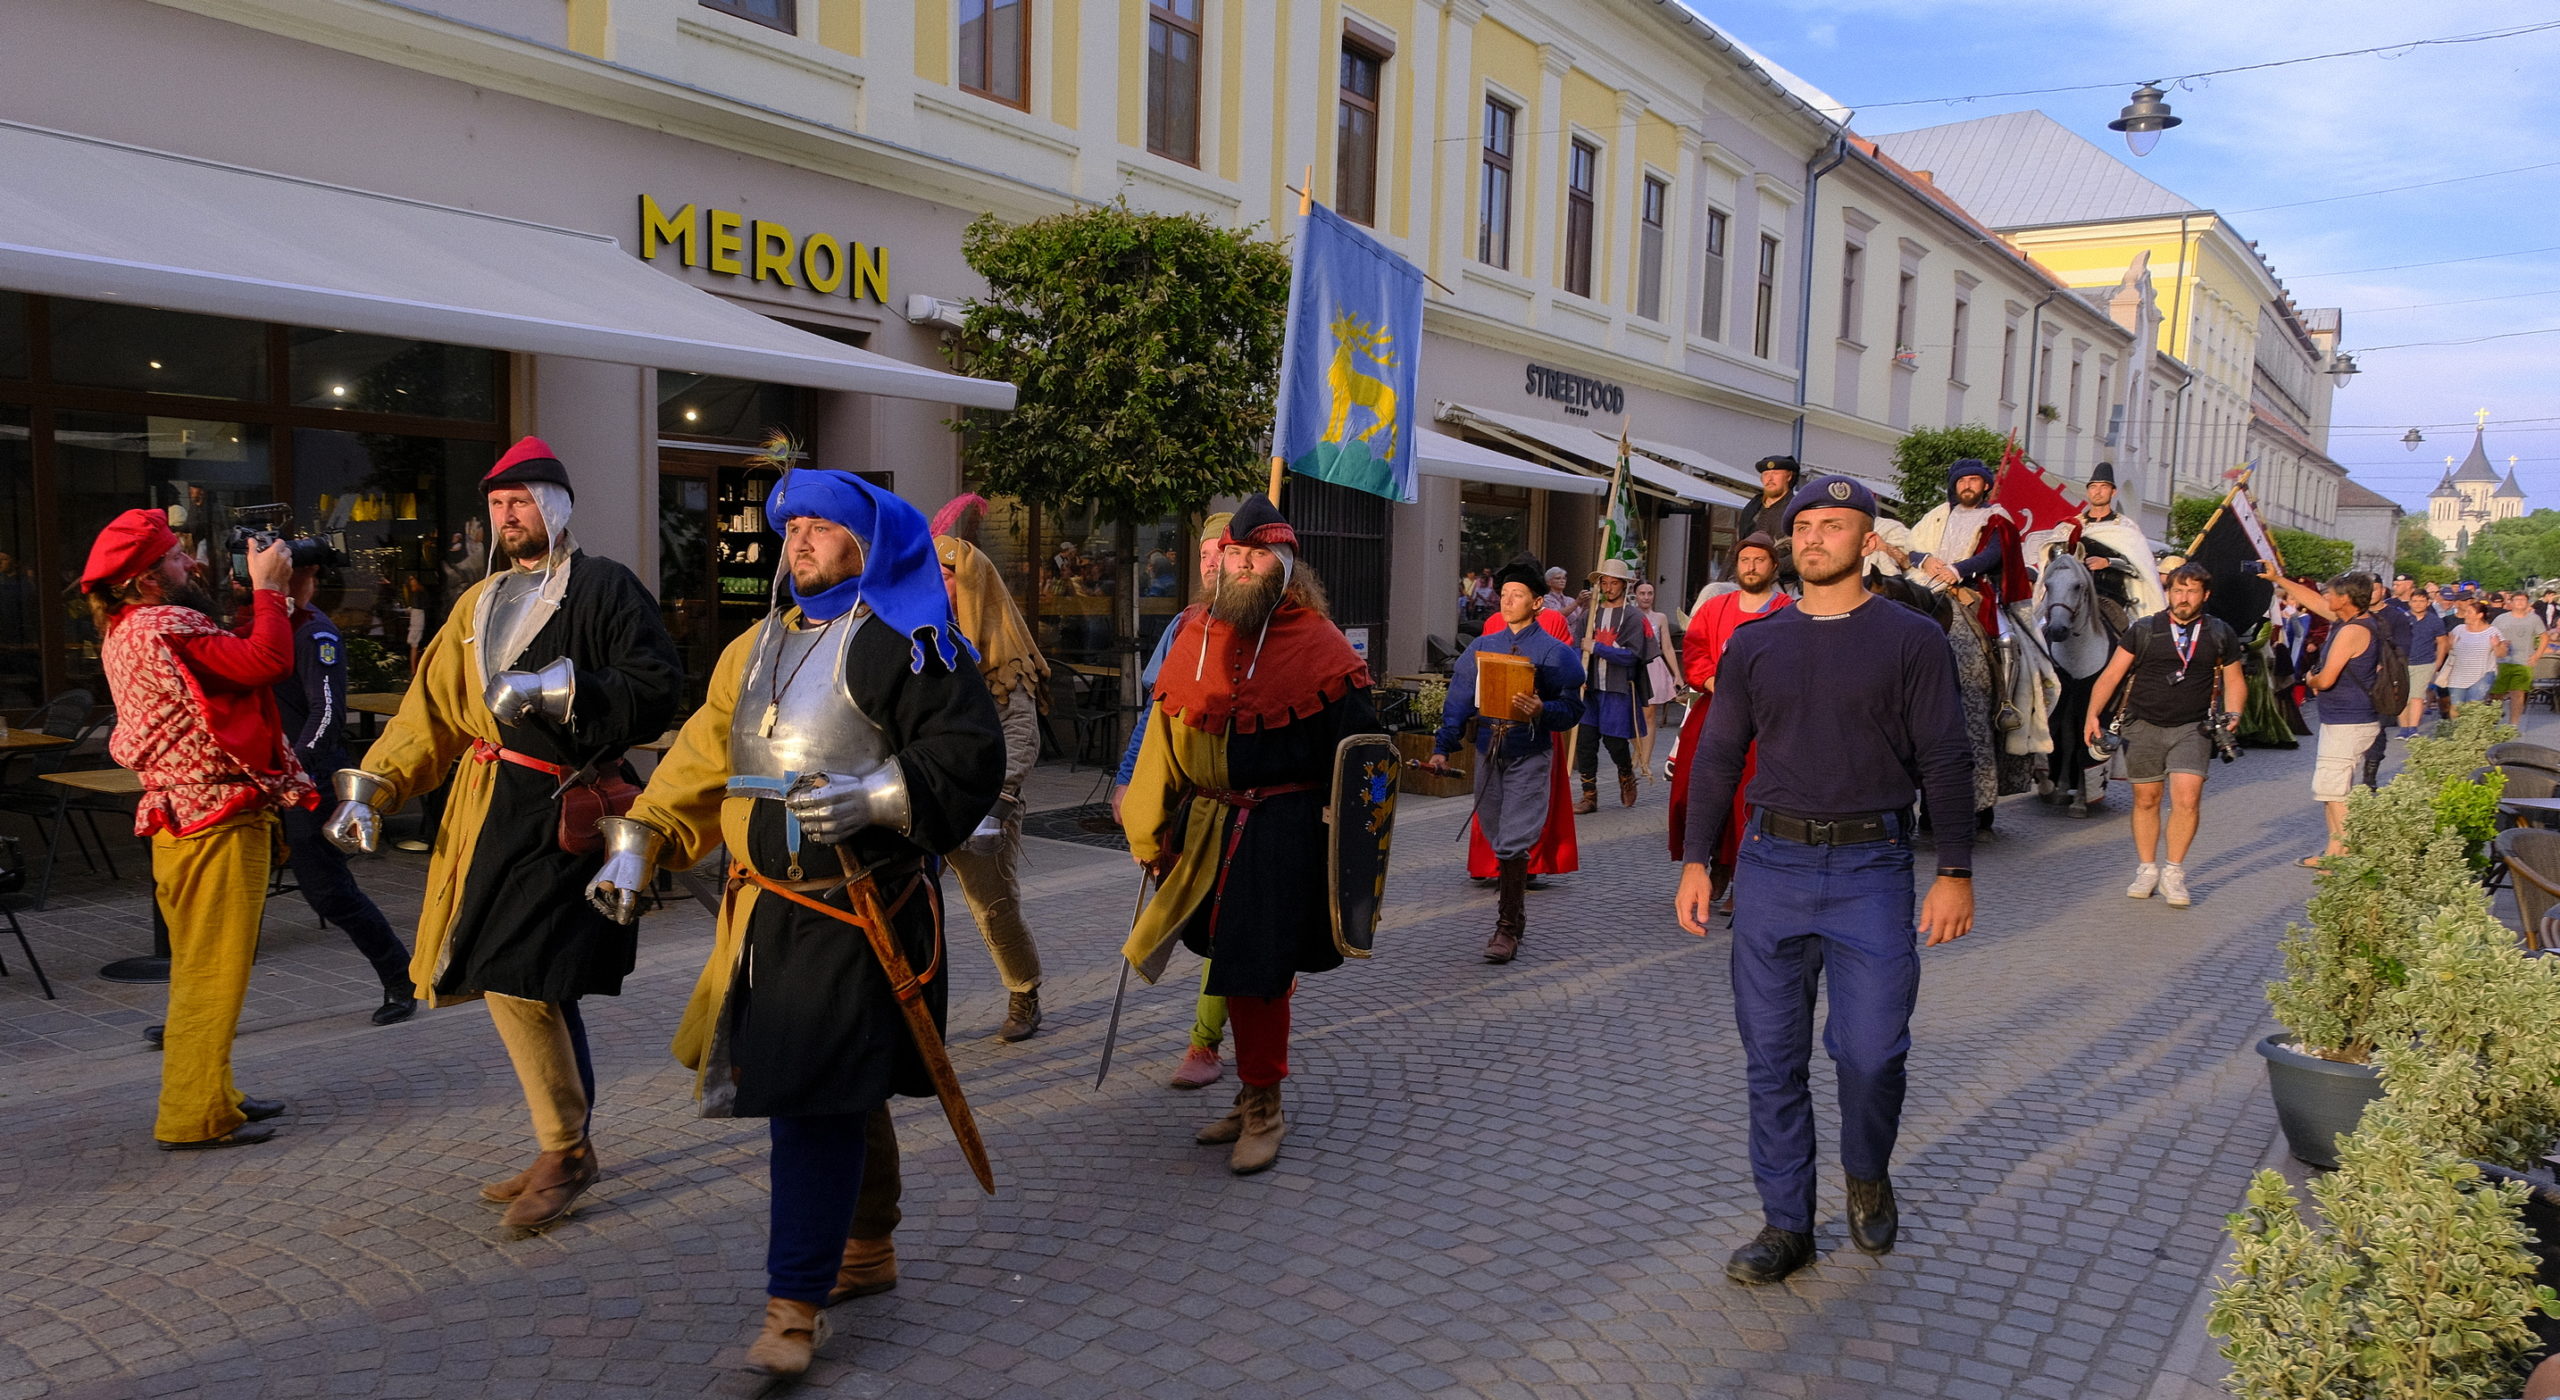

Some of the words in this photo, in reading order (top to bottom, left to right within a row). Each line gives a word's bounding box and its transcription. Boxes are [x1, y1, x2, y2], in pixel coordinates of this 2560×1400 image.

[639, 194, 889, 303] MERON
[1526, 363, 1625, 414] STREETFOOD
[1438, 538, 1444, 553] 6
[306, 675, 333, 749] JANDARMERIA
